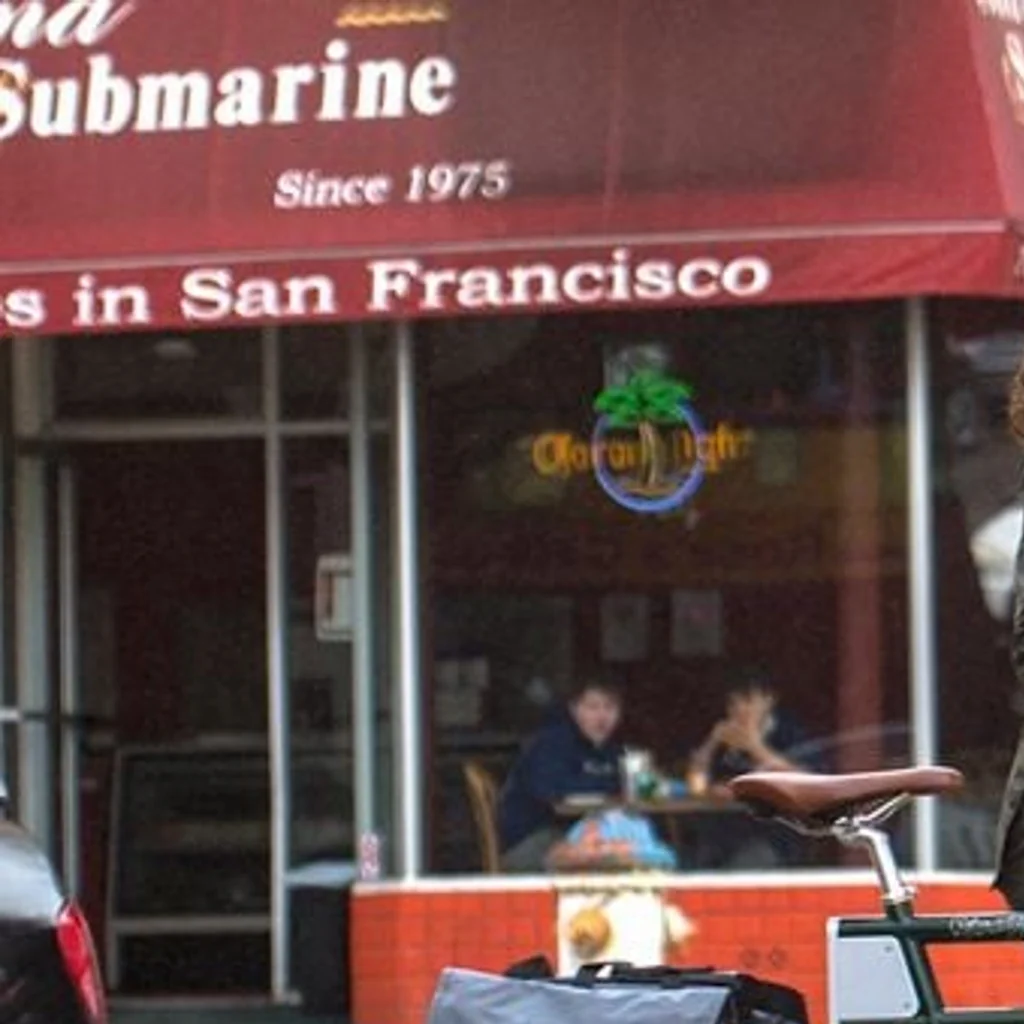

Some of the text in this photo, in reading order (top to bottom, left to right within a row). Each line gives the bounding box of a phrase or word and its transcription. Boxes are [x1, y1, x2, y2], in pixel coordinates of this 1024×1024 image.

[0, 40, 456, 142] Submarine
[273, 160, 511, 209] Since 1975
[72, 274, 151, 326] in
[180, 268, 337, 320] San
[366, 249, 770, 312] Francisco
